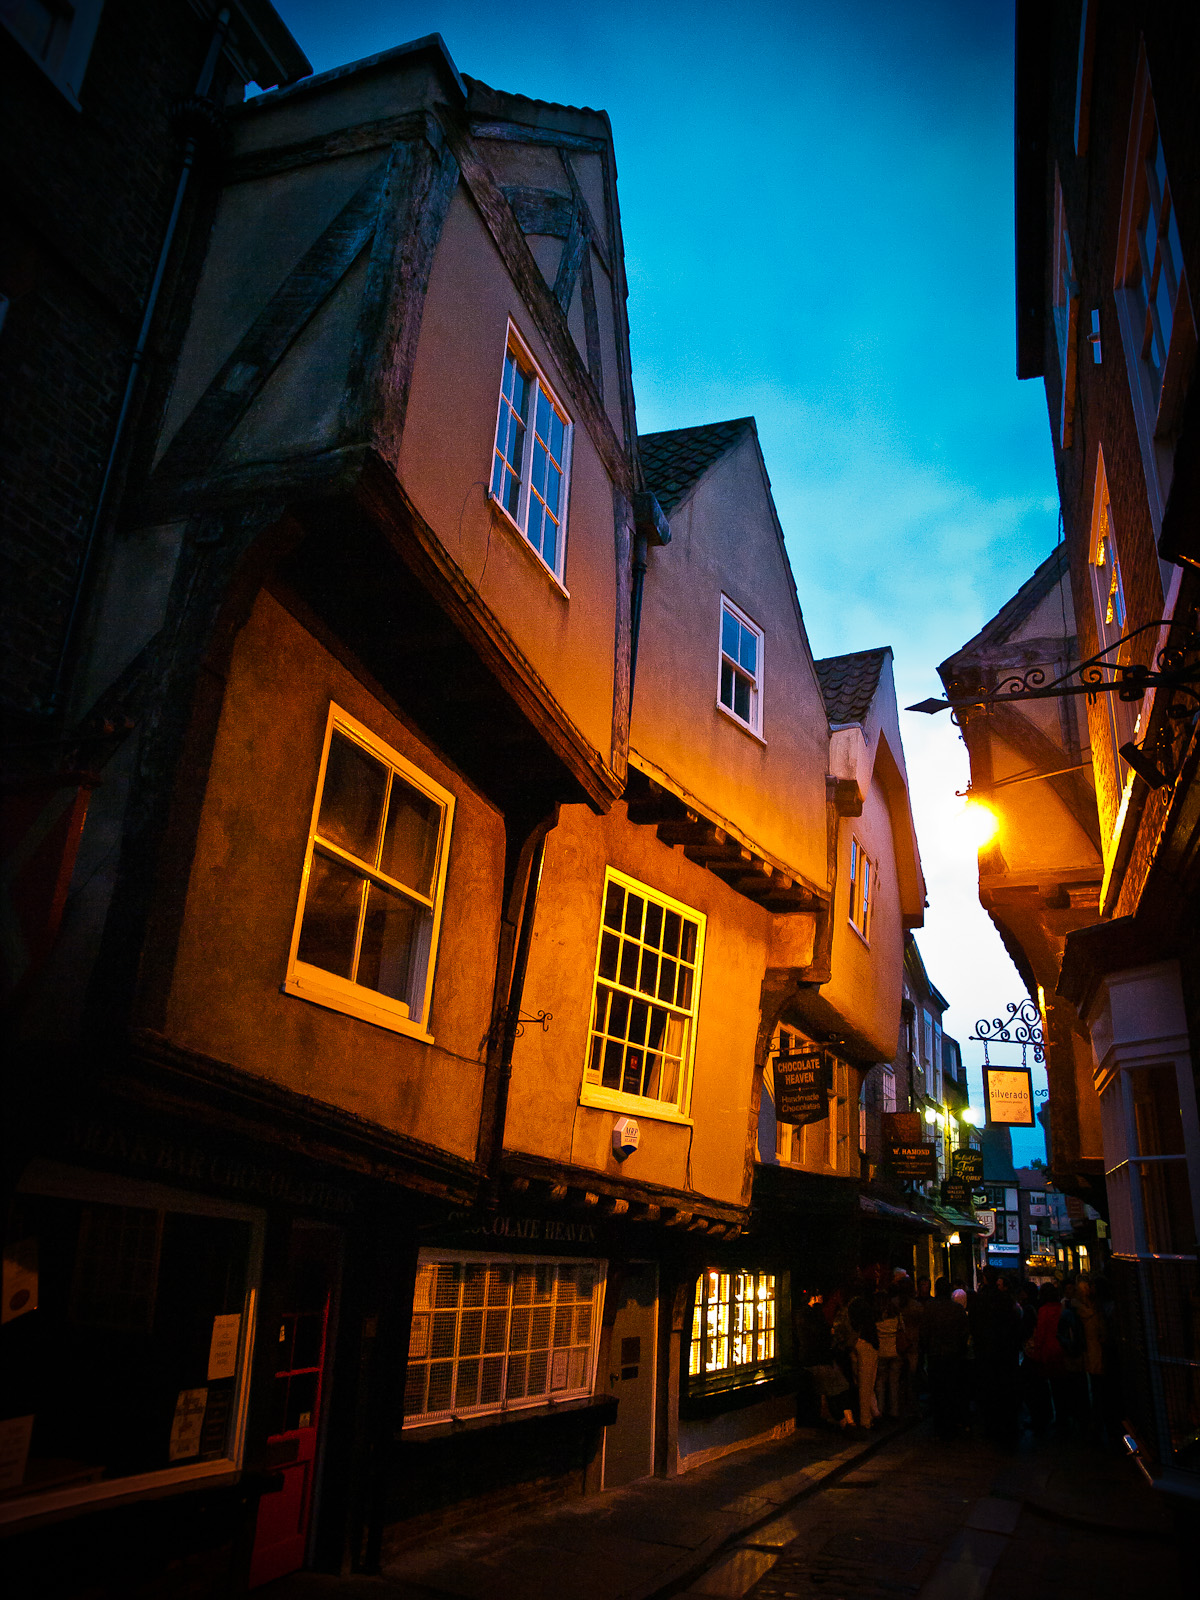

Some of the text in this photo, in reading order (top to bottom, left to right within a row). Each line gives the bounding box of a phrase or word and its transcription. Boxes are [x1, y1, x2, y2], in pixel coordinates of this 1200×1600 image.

[777, 1058, 821, 1073] CHOCOLATE
[784, 1072, 815, 1086] HEAVEN
[990, 1089, 1029, 1099] silverado
[953, 1160, 975, 1171] Tea
[544, 1218, 597, 1243] HEAVEN
